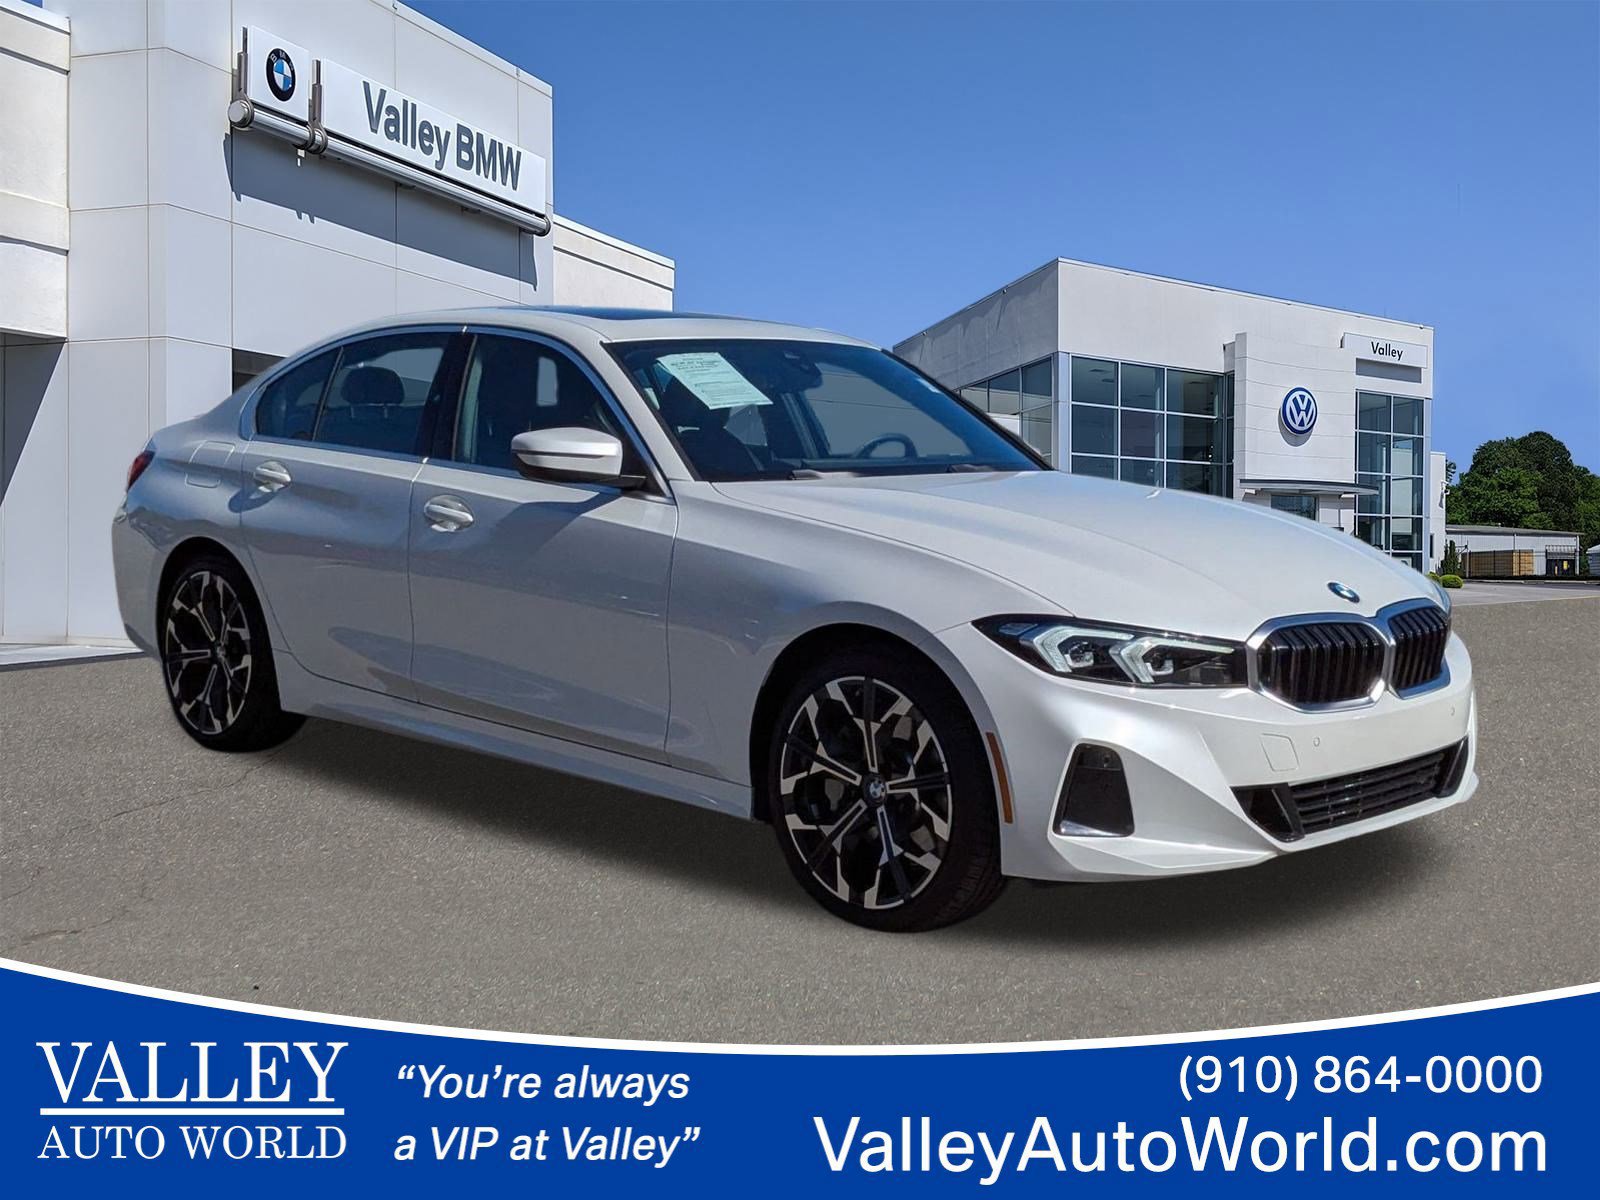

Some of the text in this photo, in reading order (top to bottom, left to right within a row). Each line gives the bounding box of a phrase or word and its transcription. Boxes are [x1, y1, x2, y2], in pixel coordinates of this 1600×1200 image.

[362, 81, 522, 191] Valley BMW
[1371, 341, 1403, 361] Valley
